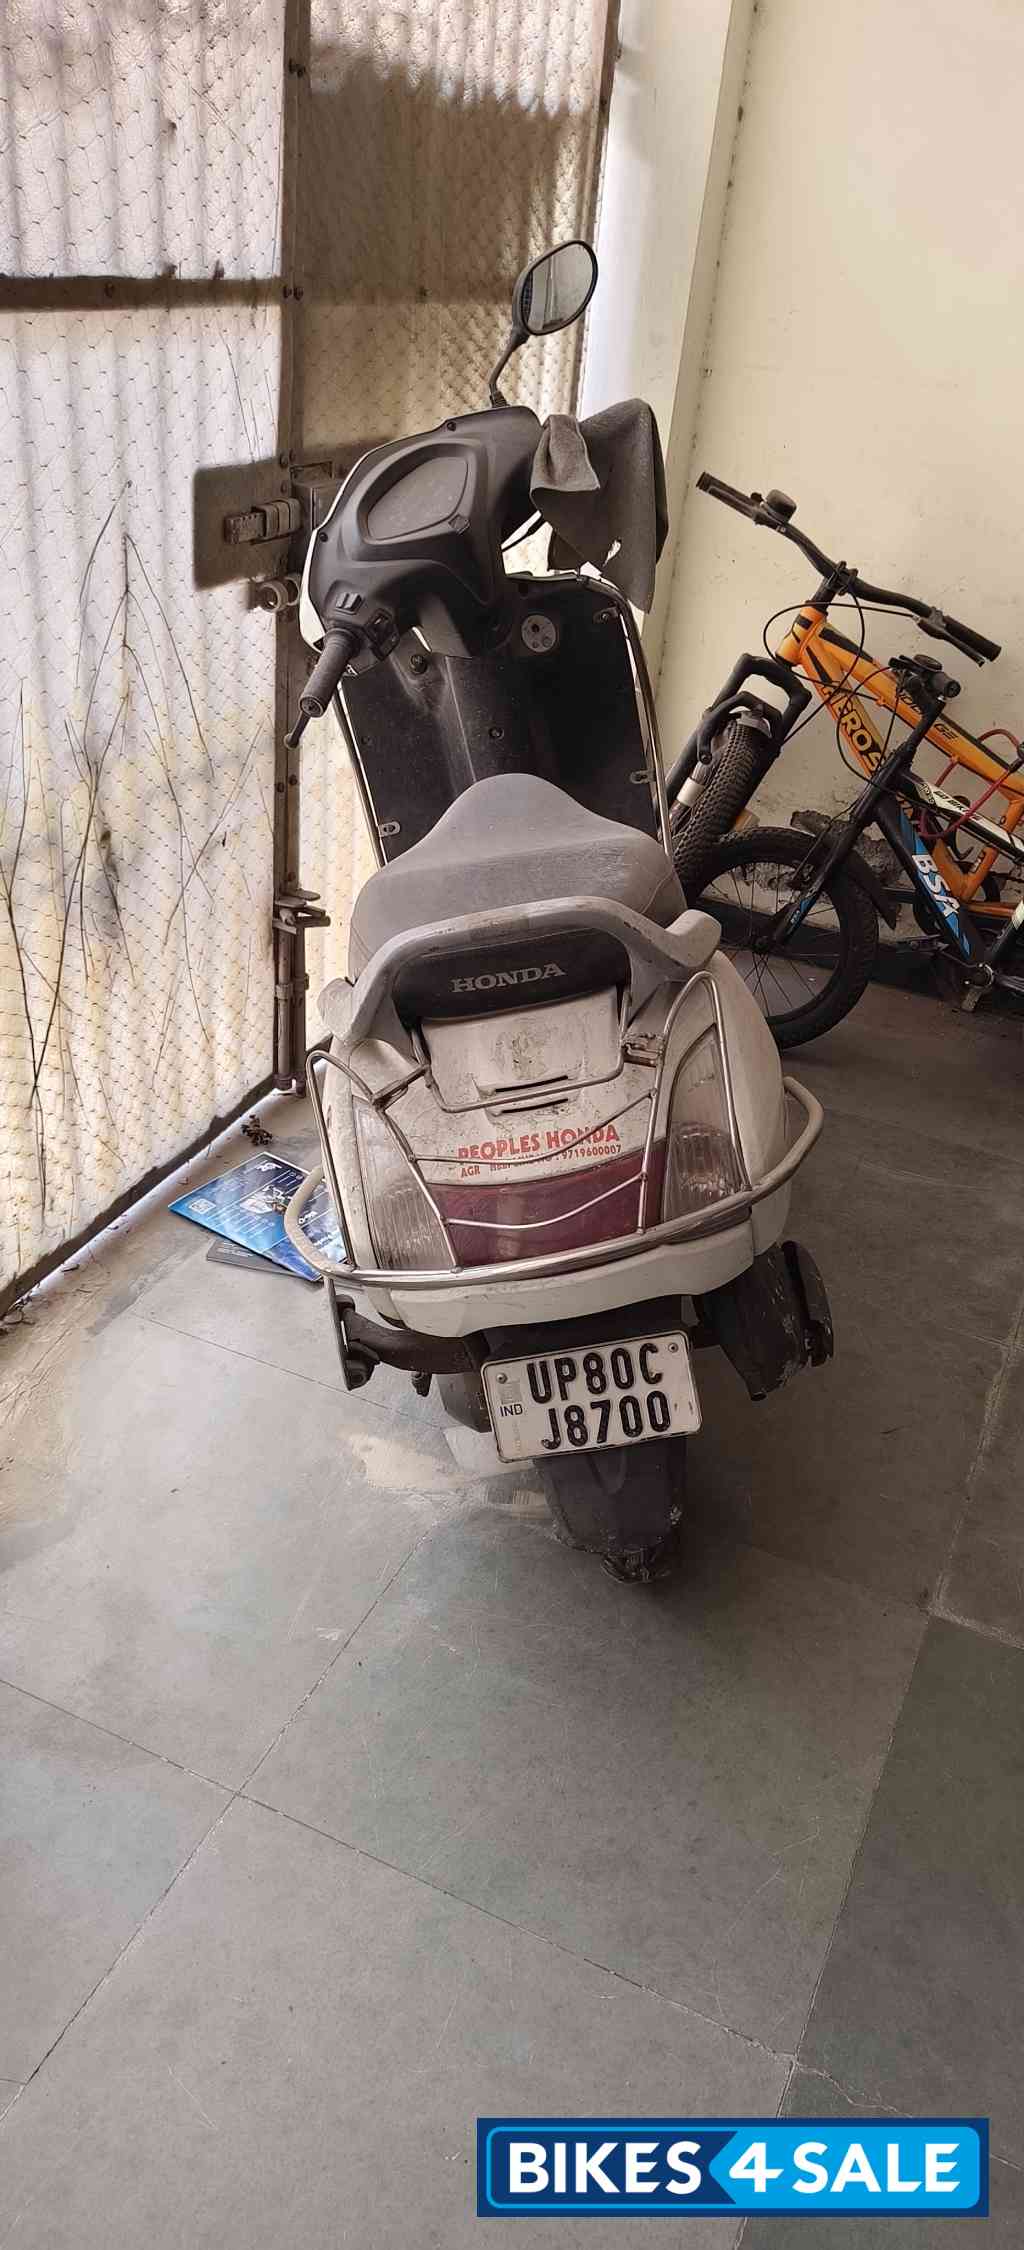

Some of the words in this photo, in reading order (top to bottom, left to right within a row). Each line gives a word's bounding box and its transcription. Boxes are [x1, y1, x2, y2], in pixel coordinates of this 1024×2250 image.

[912, 854, 960, 918] BSA
[450, 962, 566, 993] HONDA
[458, 1133, 540, 1160] PEOPLES
[527, 1343, 664, 1404] UP80C
[500, 1403, 523, 1417] IND
[541, 1390, 671, 1450] J8700
